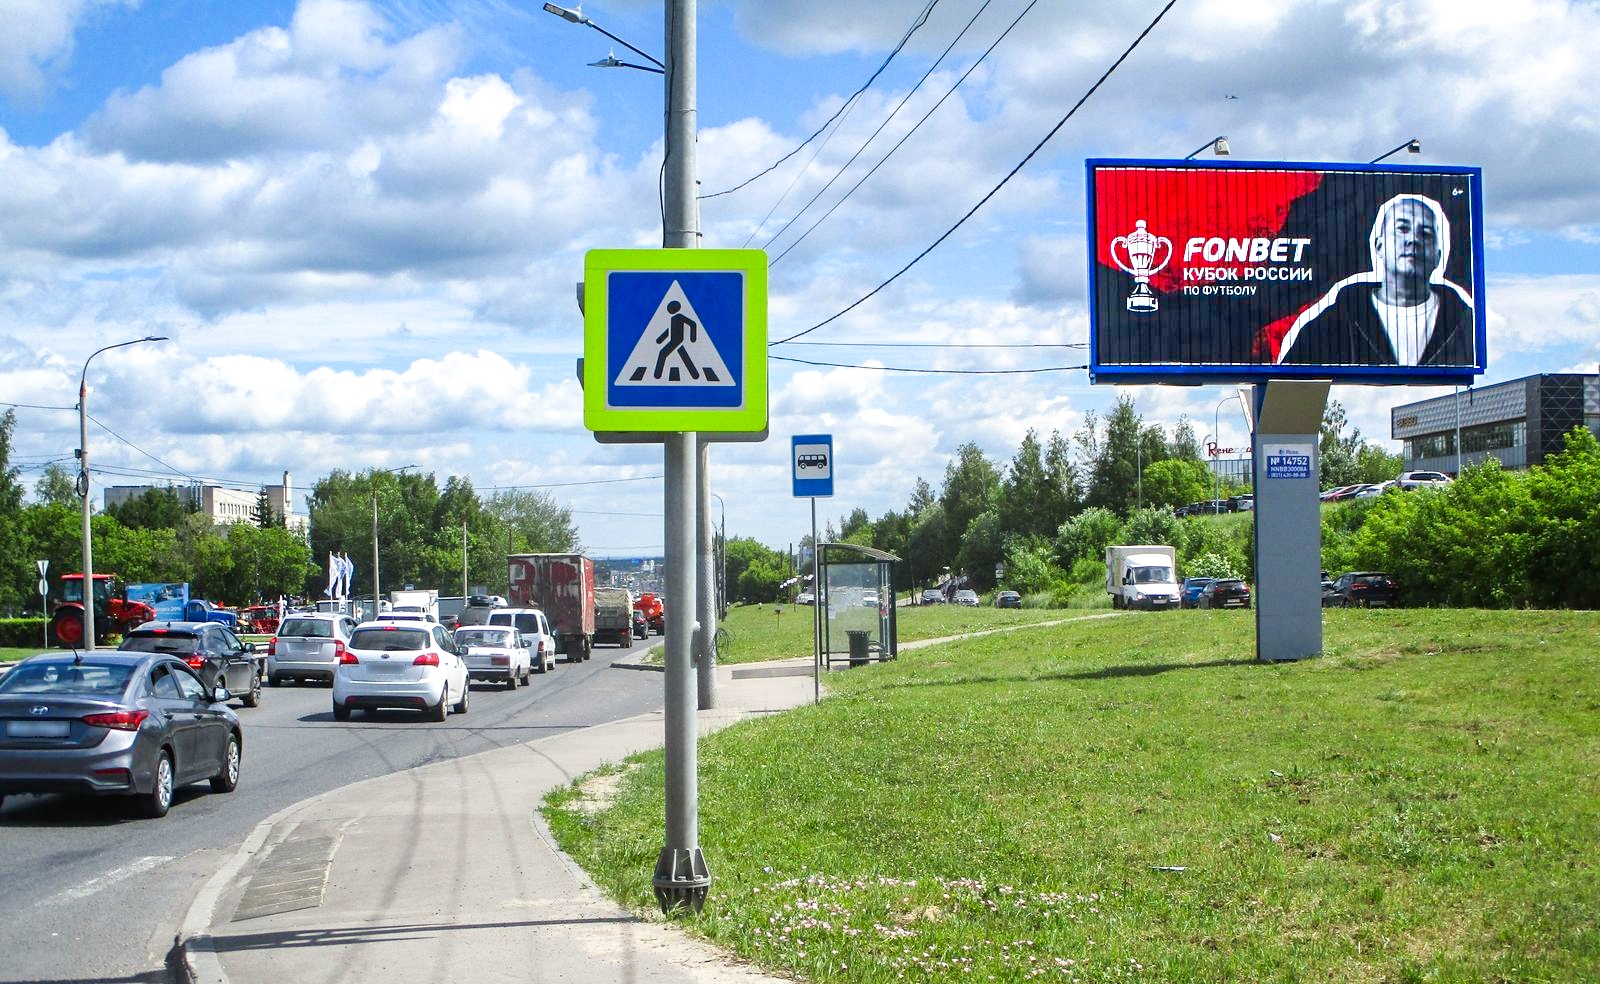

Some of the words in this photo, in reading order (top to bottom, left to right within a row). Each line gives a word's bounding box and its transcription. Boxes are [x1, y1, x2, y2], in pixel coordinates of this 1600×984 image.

[1452, 187, 1464, 196] 6+
[1183, 237, 1311, 263] FONBET
[1183, 267, 1239, 281] КУБОК
[1244, 267, 1313, 281] РОССИИ
[1183, 285, 1200, 296] ПО
[1202, 285, 1257, 296] ФУТБОЛУ
[1270, 457, 1280, 465] №
[1282, 457, 1308, 465] 14752
